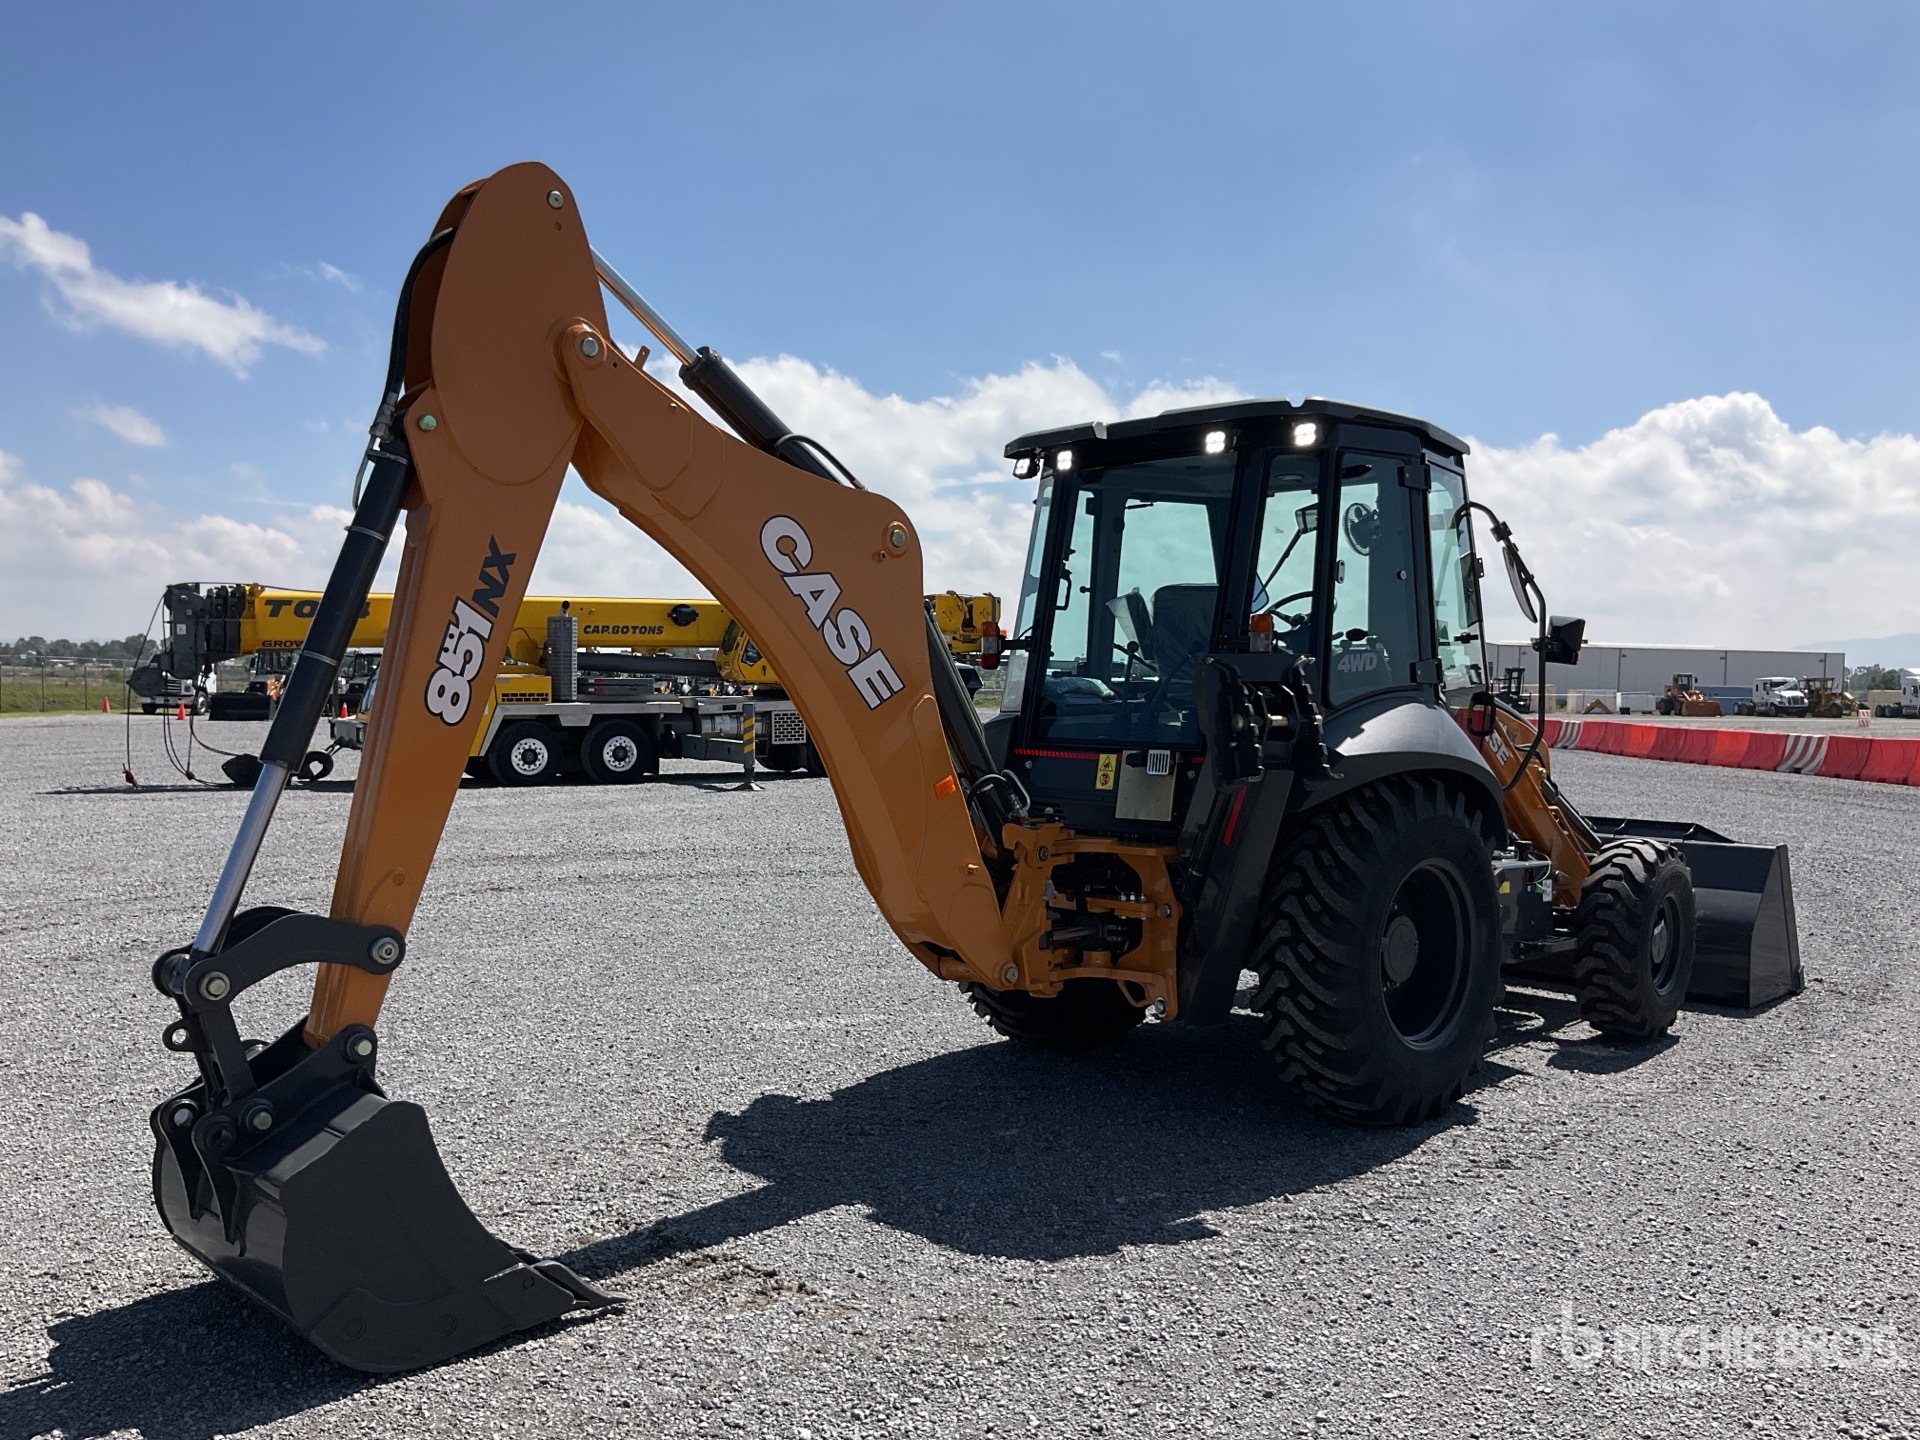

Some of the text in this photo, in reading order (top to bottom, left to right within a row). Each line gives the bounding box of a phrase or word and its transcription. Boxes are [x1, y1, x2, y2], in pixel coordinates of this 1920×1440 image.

[760, 514, 906, 711] CASE
[631, 625, 664, 635] TONS
[1337, 652, 1378, 673] 4WD
